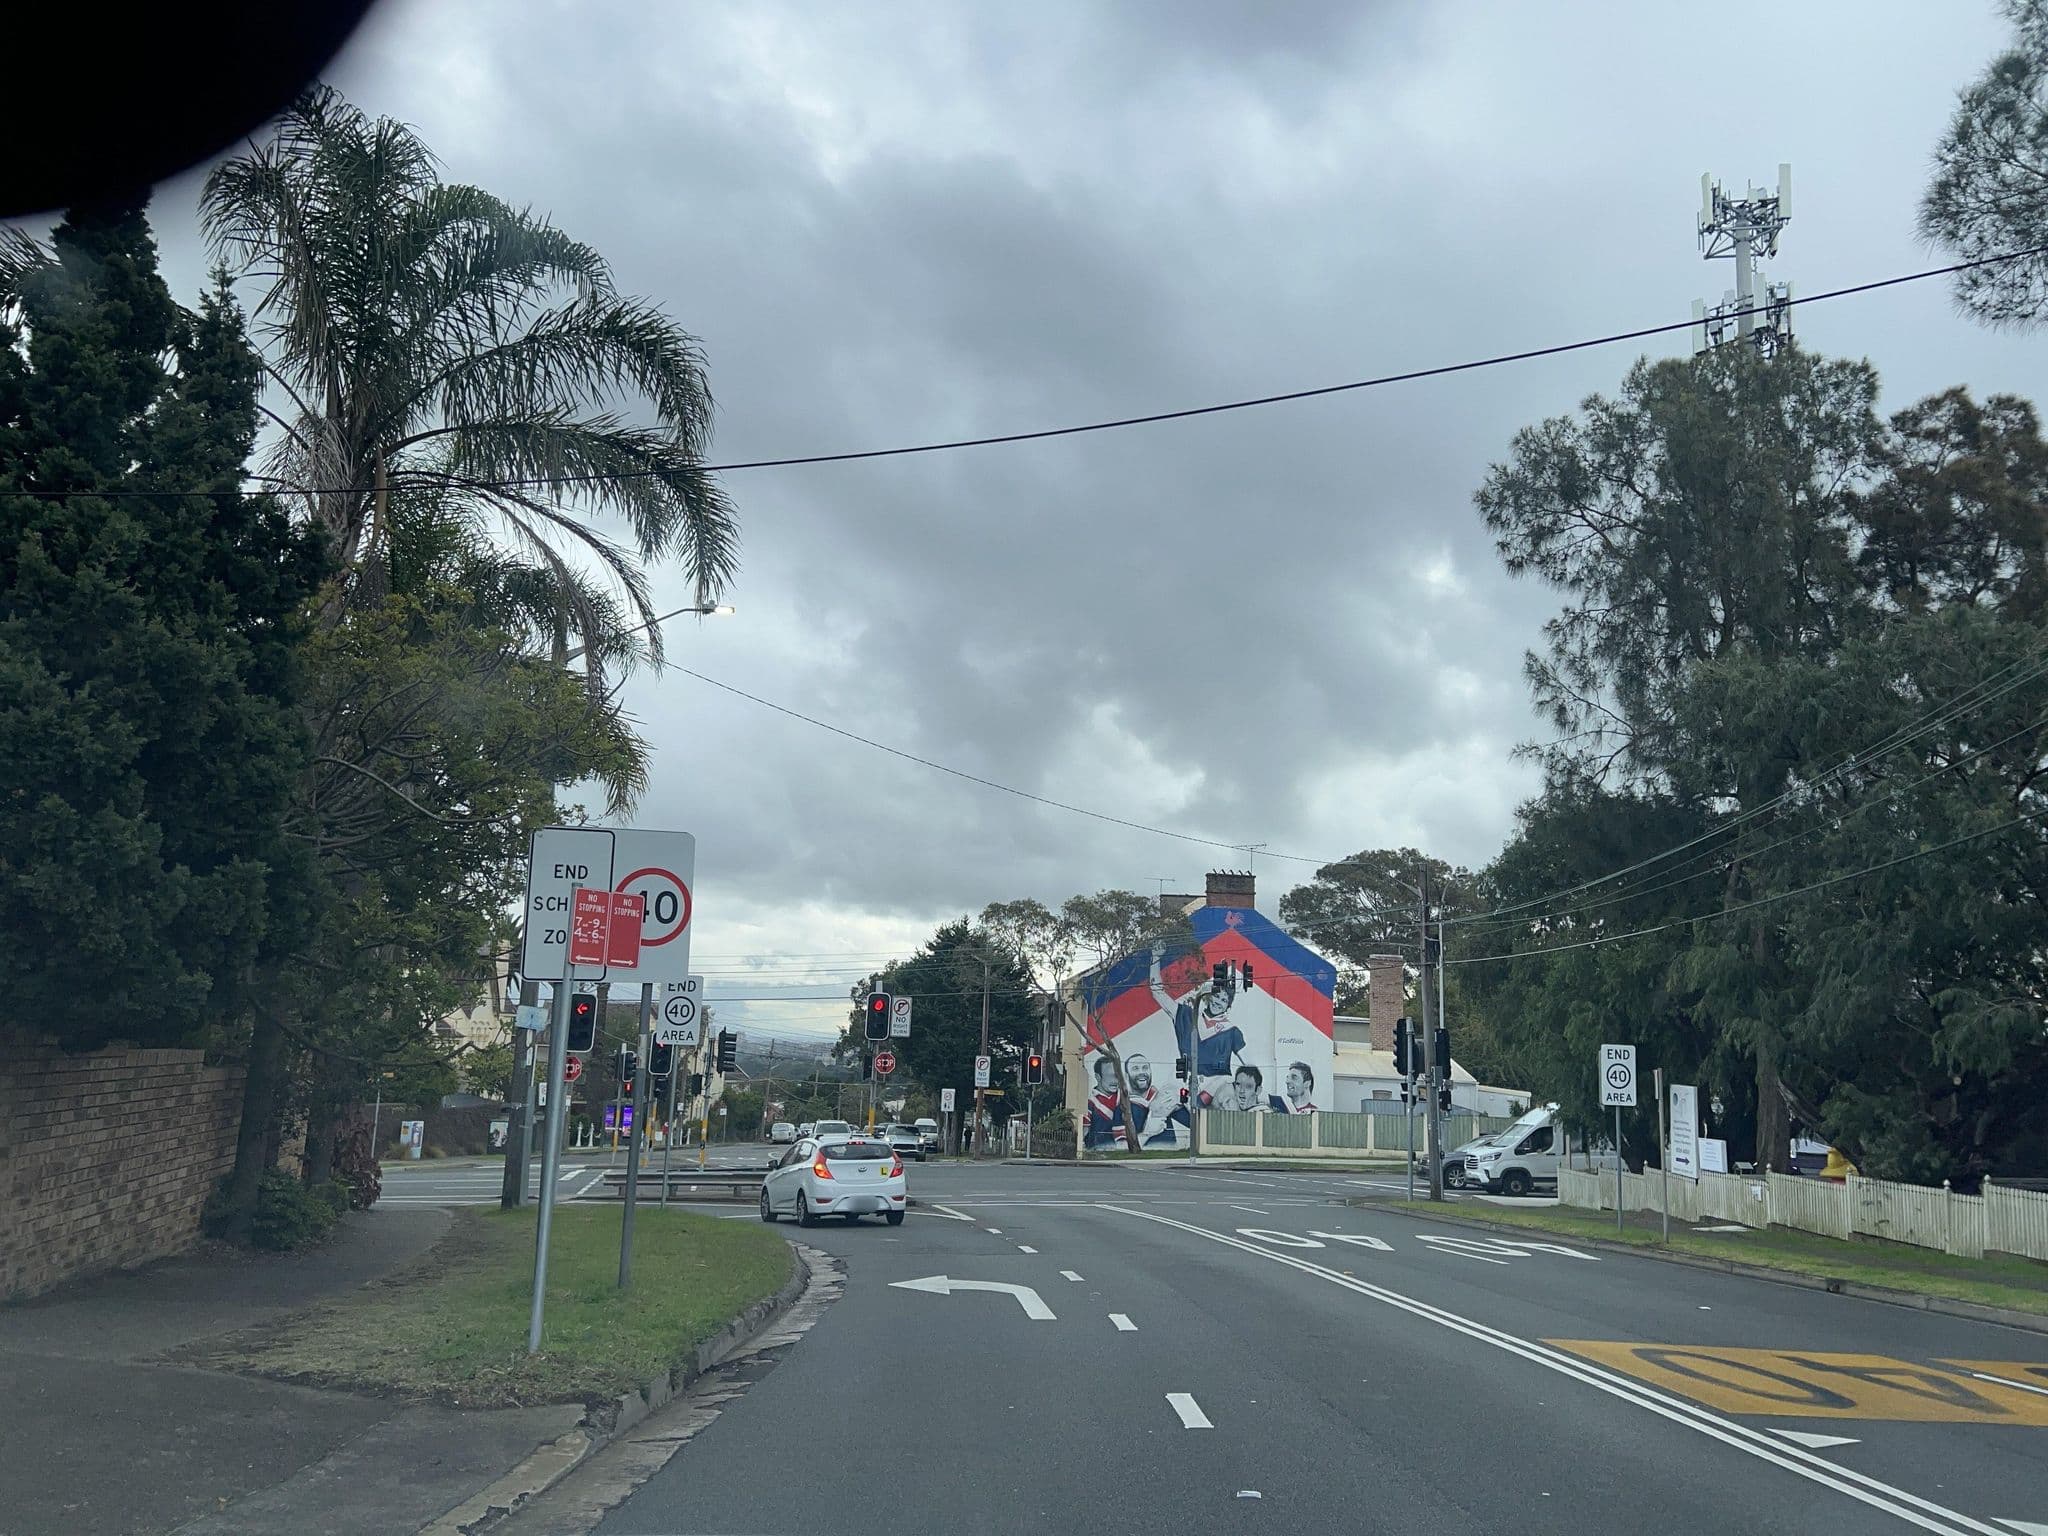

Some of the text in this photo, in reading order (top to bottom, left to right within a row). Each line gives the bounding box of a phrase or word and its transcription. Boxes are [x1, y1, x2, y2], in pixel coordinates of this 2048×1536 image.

[554, 864, 588, 879] END
[533, 896, 568, 911] SCH
[588, 894, 597, 902] NO
[623, 898, 632, 906] NO
[579, 903, 605, 913] STOPPING
[614, 907, 640, 917] STOPPING
[544, 929, 566, 944] ZO
[668, 981, 696, 992] END
[668, 1004, 690, 1018] 40
[661, 1030, 694, 1040] AREA
[1607, 1049, 1630, 1060] END
[876, 1059, 894, 1067] STOP
[1609, 1070, 1627, 1082] 40
[1606, 1093, 1633, 1103] AREA
[1631, 1348, 2015, 1415] 40
